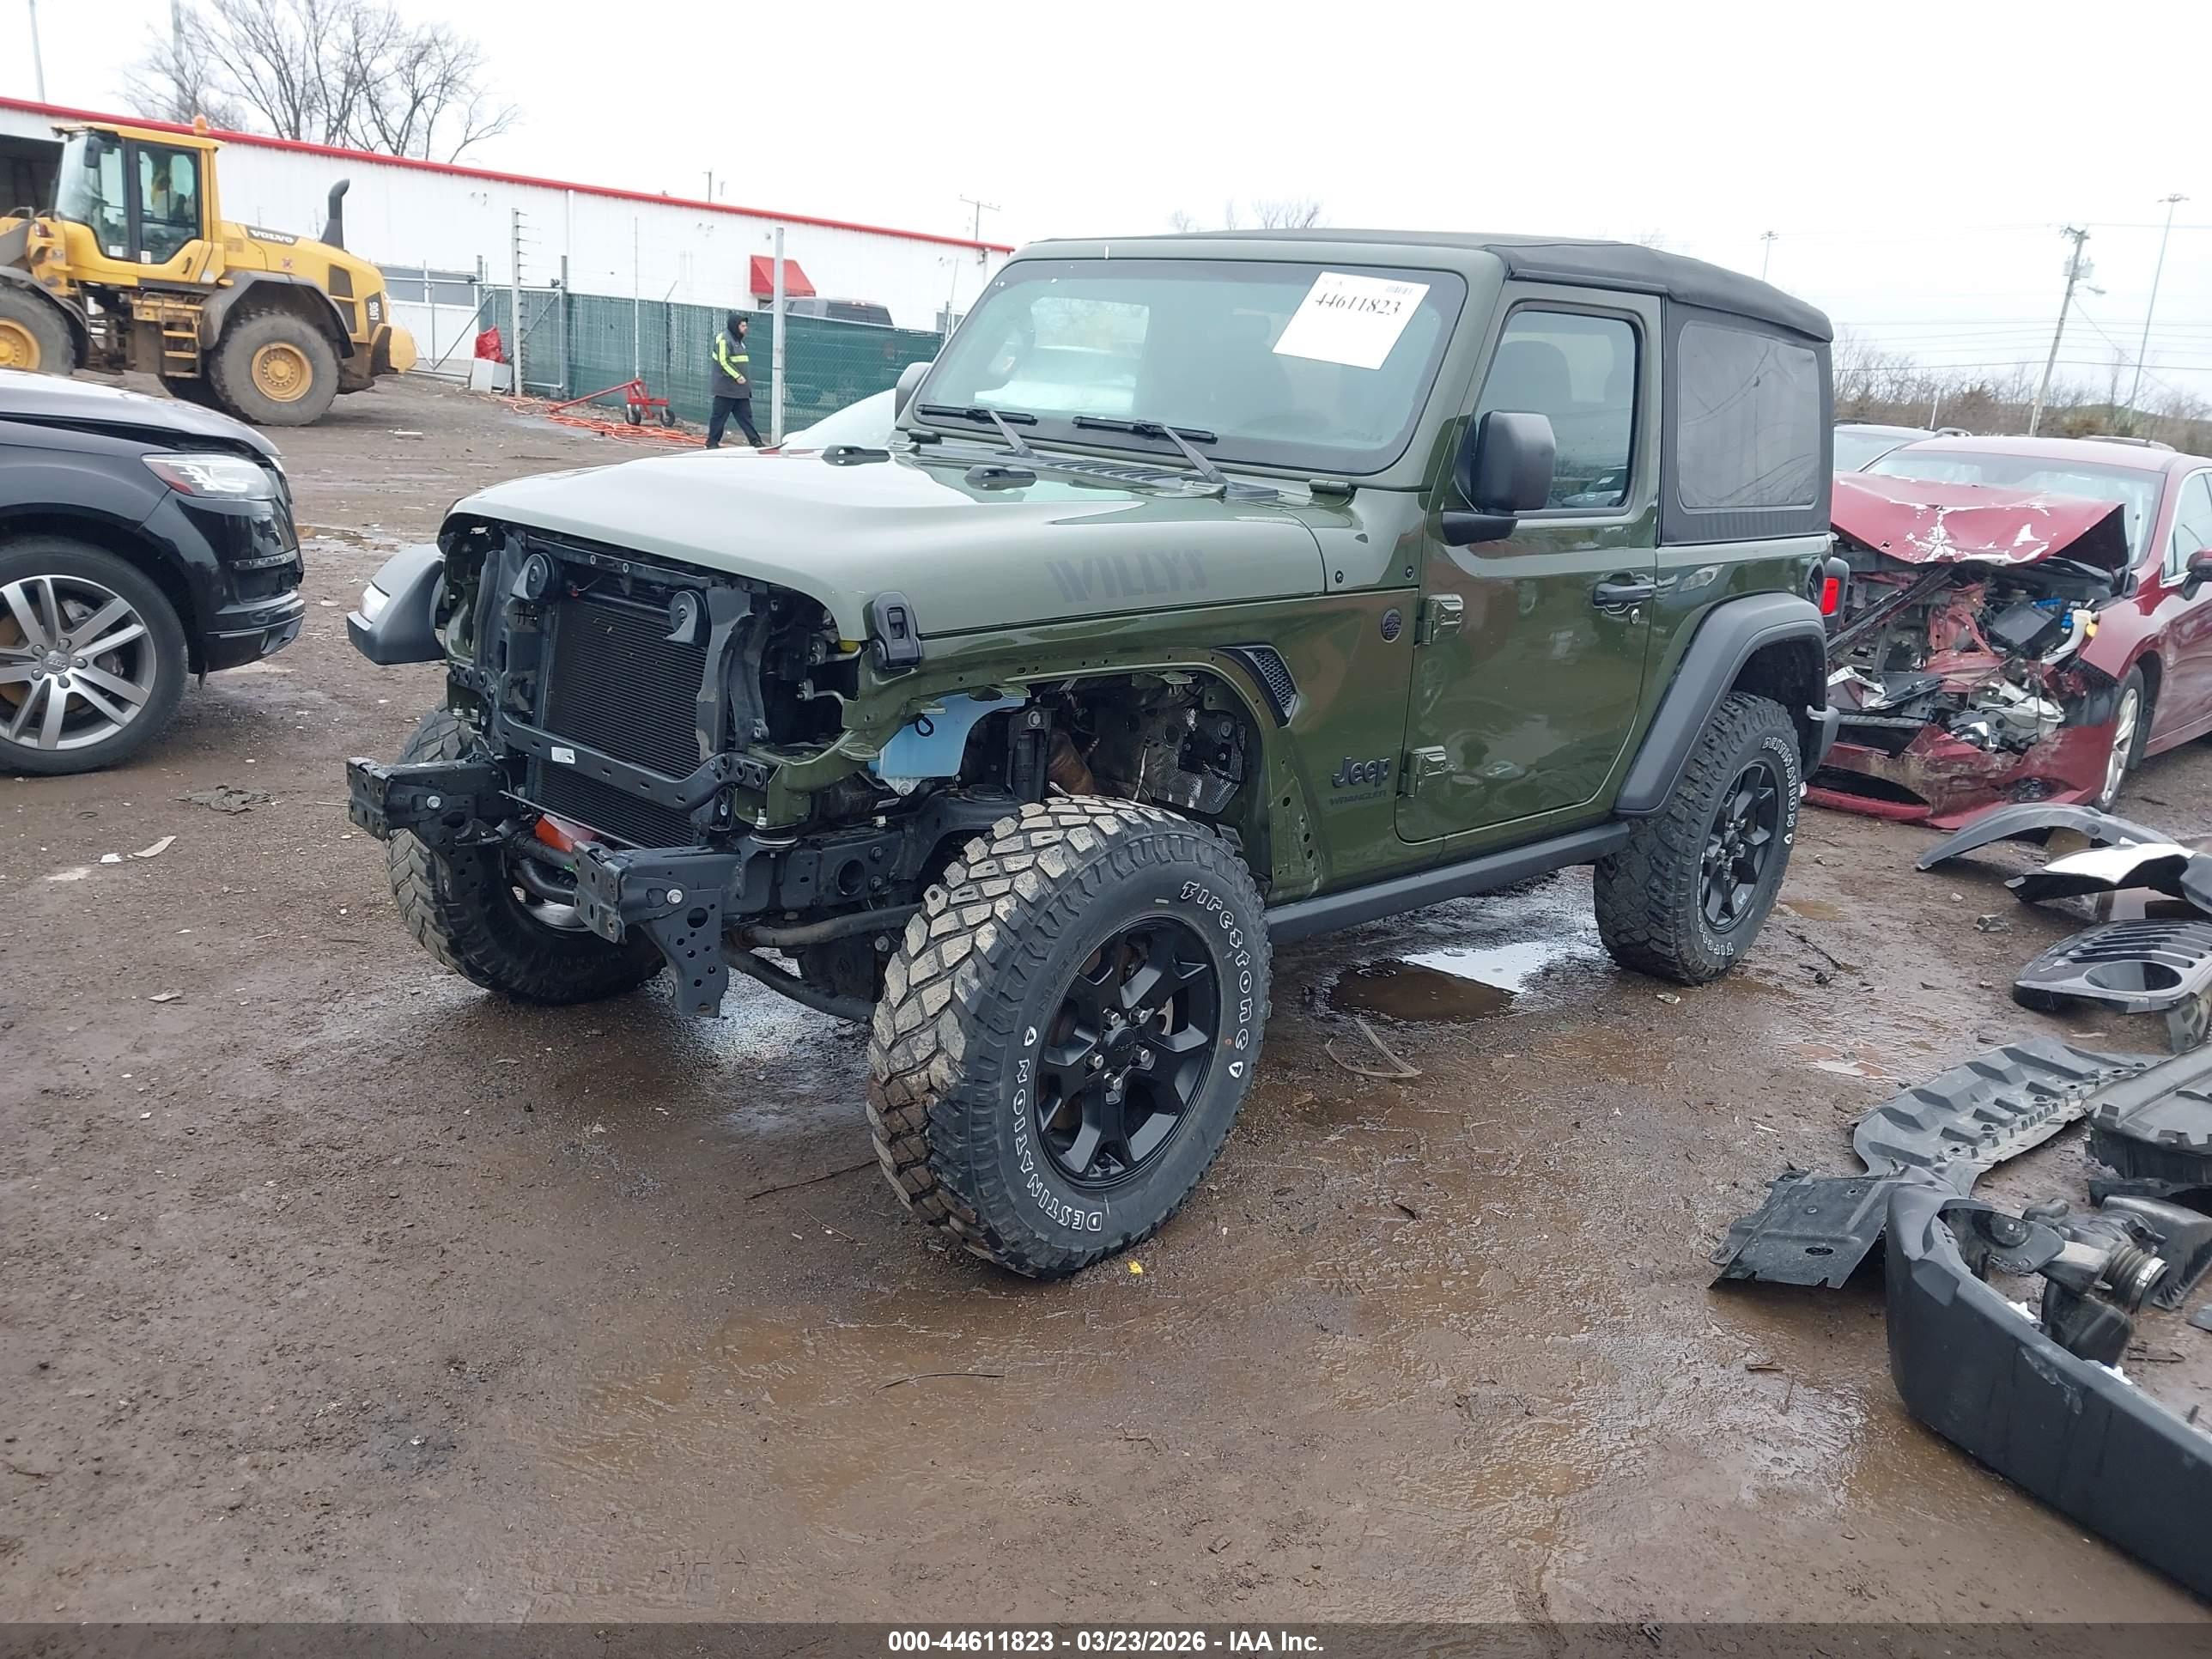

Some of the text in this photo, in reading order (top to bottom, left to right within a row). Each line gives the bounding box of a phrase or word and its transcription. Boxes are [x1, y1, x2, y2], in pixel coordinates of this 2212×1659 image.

[249, 228, 294, 245] VOLVO
[1315, 292, 1401, 316] 44611823
[1043, 549, 1207, 603] WILLYS
[1332, 756, 1391, 788] Jeep
[1761, 737, 1797, 828] DESTINATION
[1180, 880, 1254, 1052] Firestone
[1012, 1058, 1103, 1232] DESTINATION
